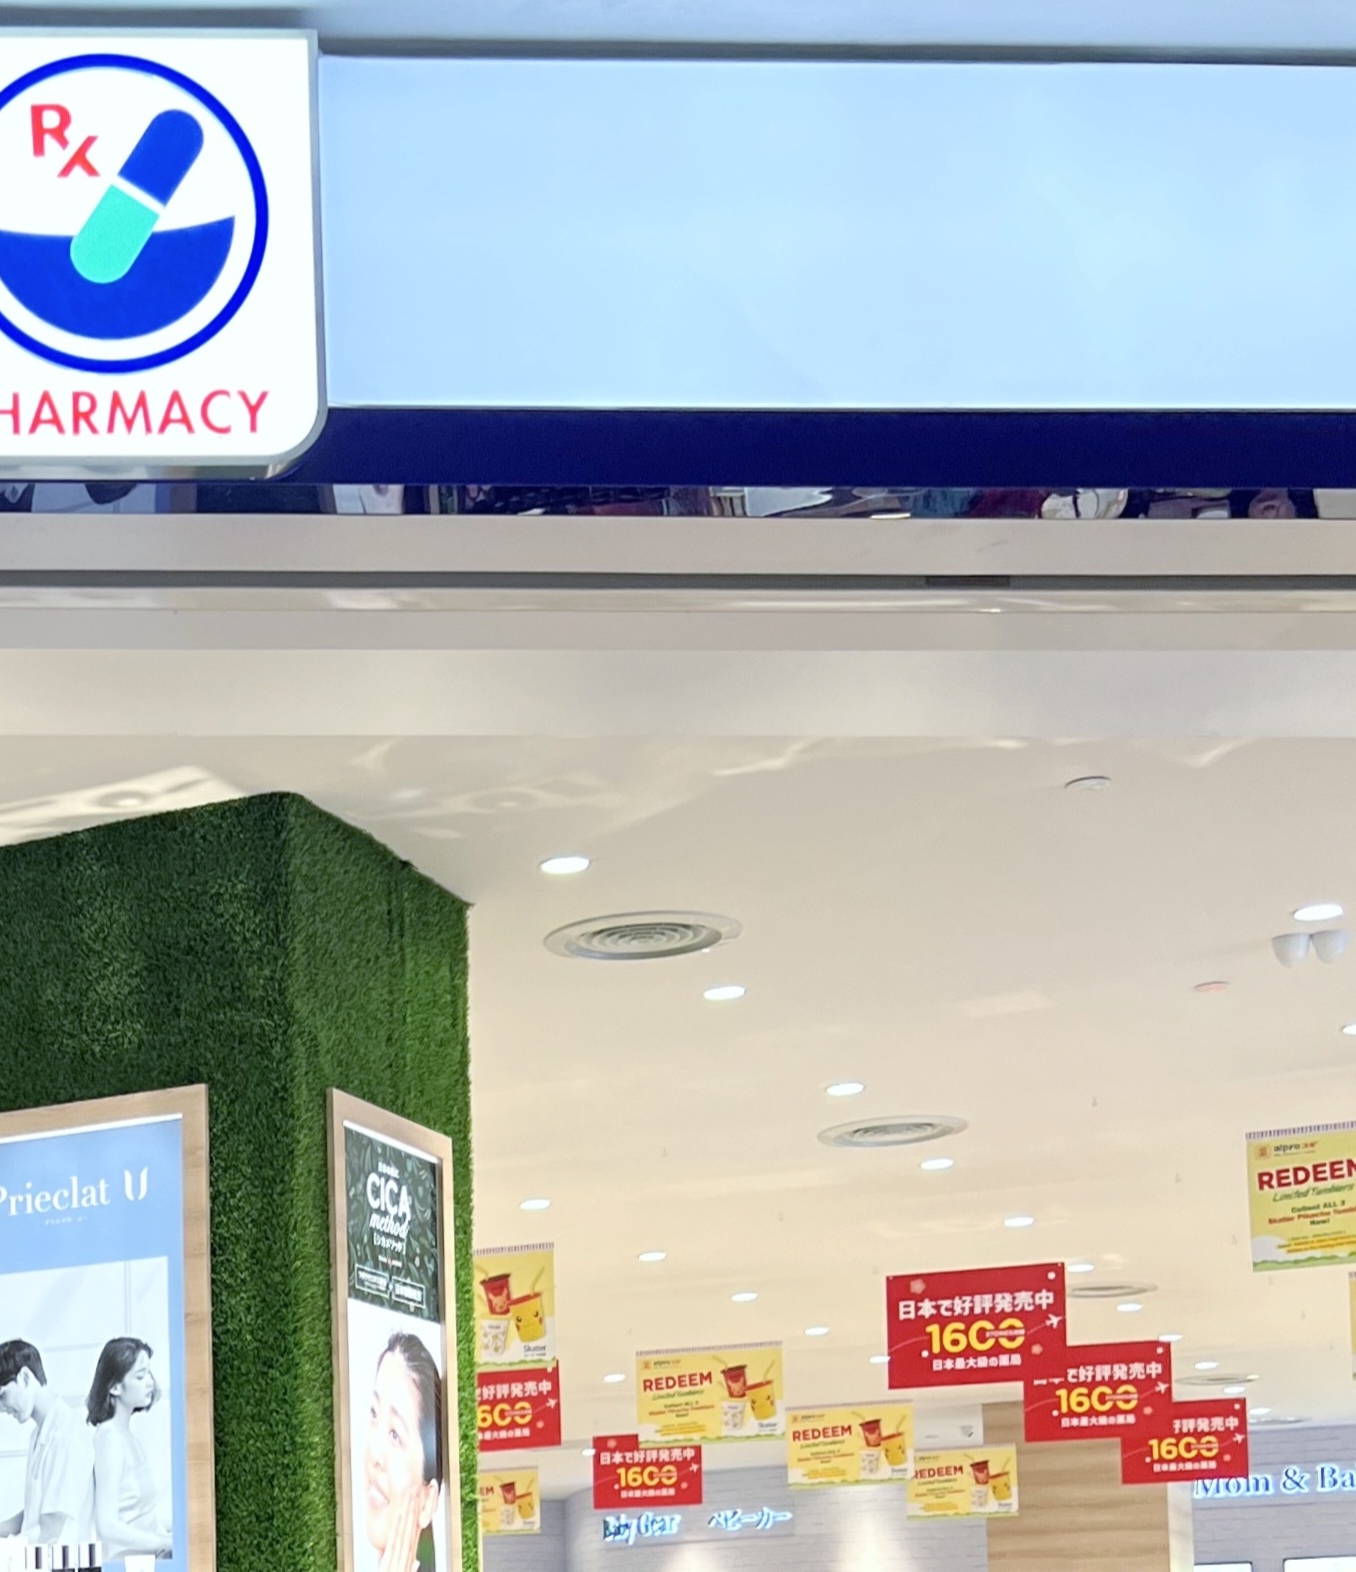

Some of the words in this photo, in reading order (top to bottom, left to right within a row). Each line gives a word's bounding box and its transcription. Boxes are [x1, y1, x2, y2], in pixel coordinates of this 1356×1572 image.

[367, 1173, 412, 1222] CICA
[370, 1213, 411, 1241] method
[899, 1289, 1054, 1320] 日本で好評発売中
[925, 1318, 1025, 1354] 1600
[643, 1371, 713, 1392] REDEEM
[1055, 1384, 1138, 1413] 1600
[792, 1425, 852, 1442] REDEEM
[1149, 1435, 1219, 1460] 1600
[616, 1465, 678, 1486] 1600
[1194, 1474, 1272, 1498] Mom
[1282, 1466, 1310, 1493] &
[1317, 1463, 1356, 1493] Ba
